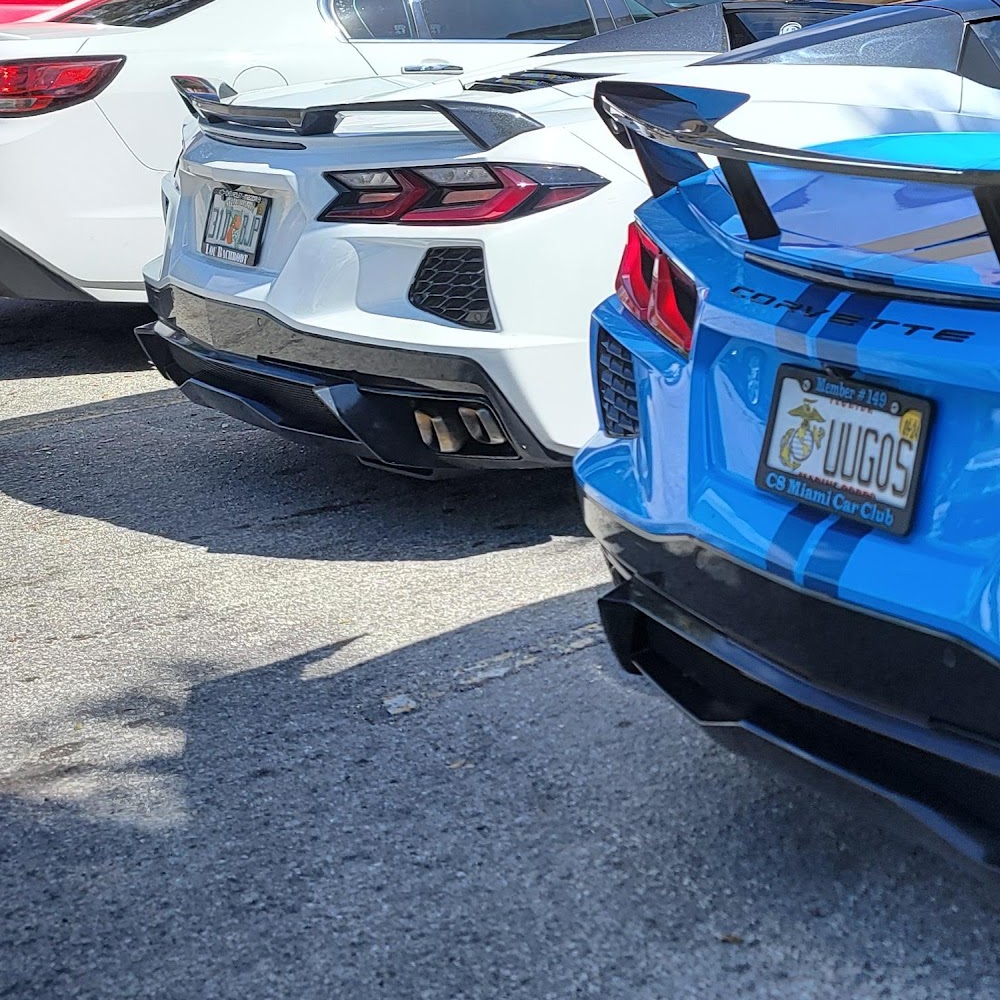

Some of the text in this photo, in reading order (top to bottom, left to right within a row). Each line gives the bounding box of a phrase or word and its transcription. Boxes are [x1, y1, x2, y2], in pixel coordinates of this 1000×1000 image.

[729, 284, 976, 343] CORVETTE
[815, 377, 856, 400] Member
[856, 388, 888, 409] #149
[787, 478, 832, 506] Miami
[832, 494, 859, 515] Car
[859, 502, 895, 527] Club
